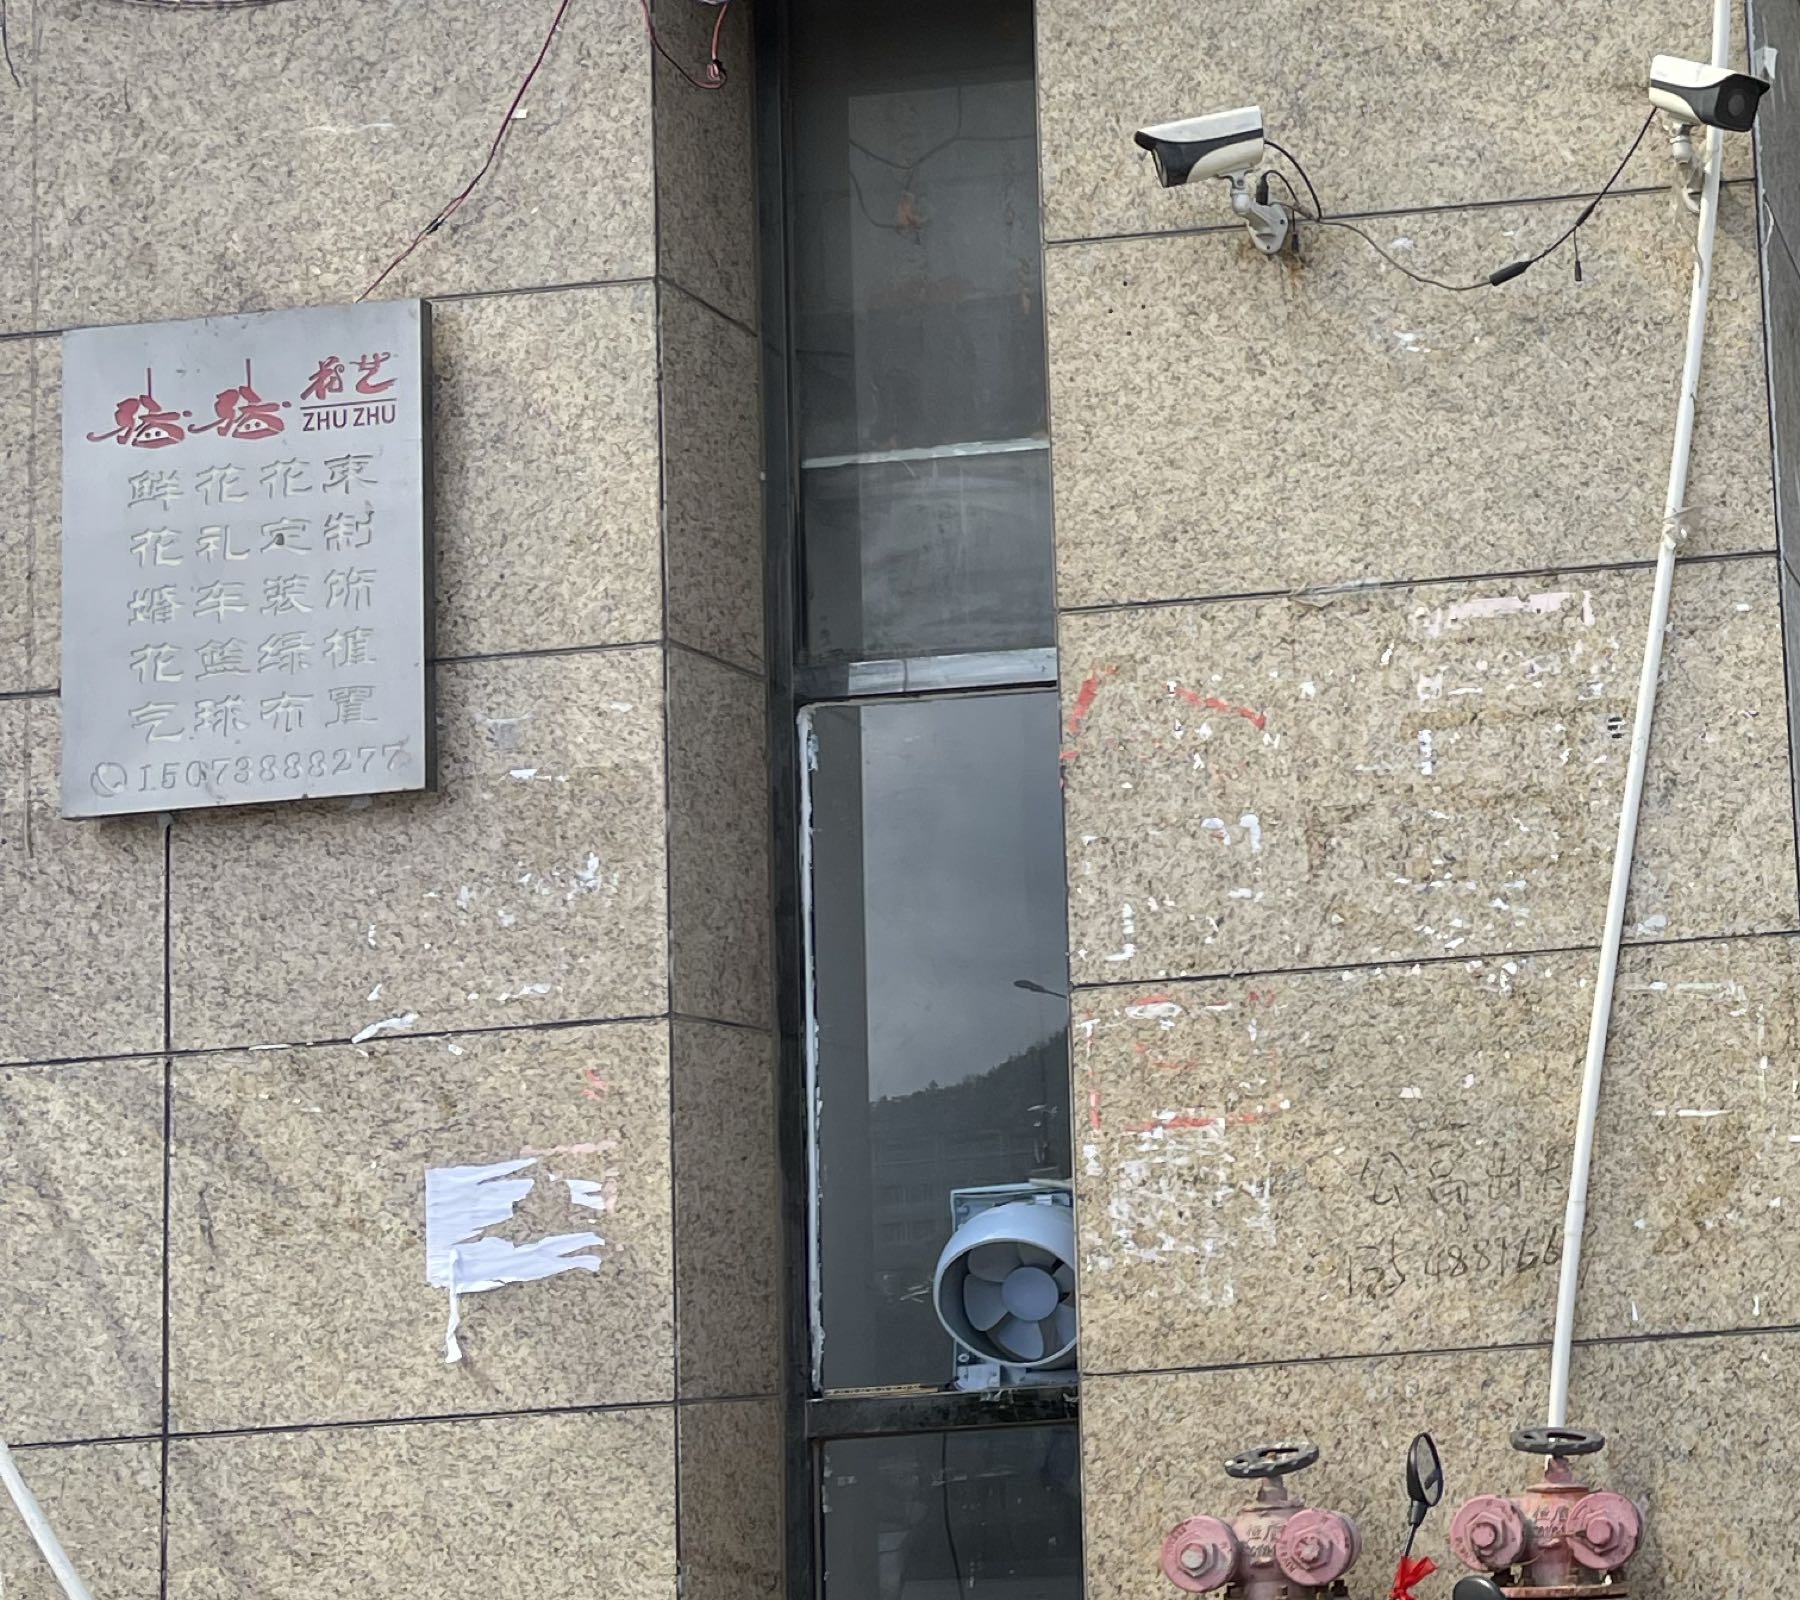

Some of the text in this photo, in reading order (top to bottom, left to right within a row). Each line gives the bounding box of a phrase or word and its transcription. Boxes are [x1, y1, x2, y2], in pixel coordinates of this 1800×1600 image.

[302, 404, 396, 432] ZHU ZHU
[127, 452, 378, 510] 鲜花花束
[129, 510, 375, 568] 花礼定制
[128, 565, 378, 626] 婚车装饰
[128, 624, 377, 684] 花篮绿植
[128, 684, 379, 743] 气球布置
[139, 741, 400, 790] 15073888277
